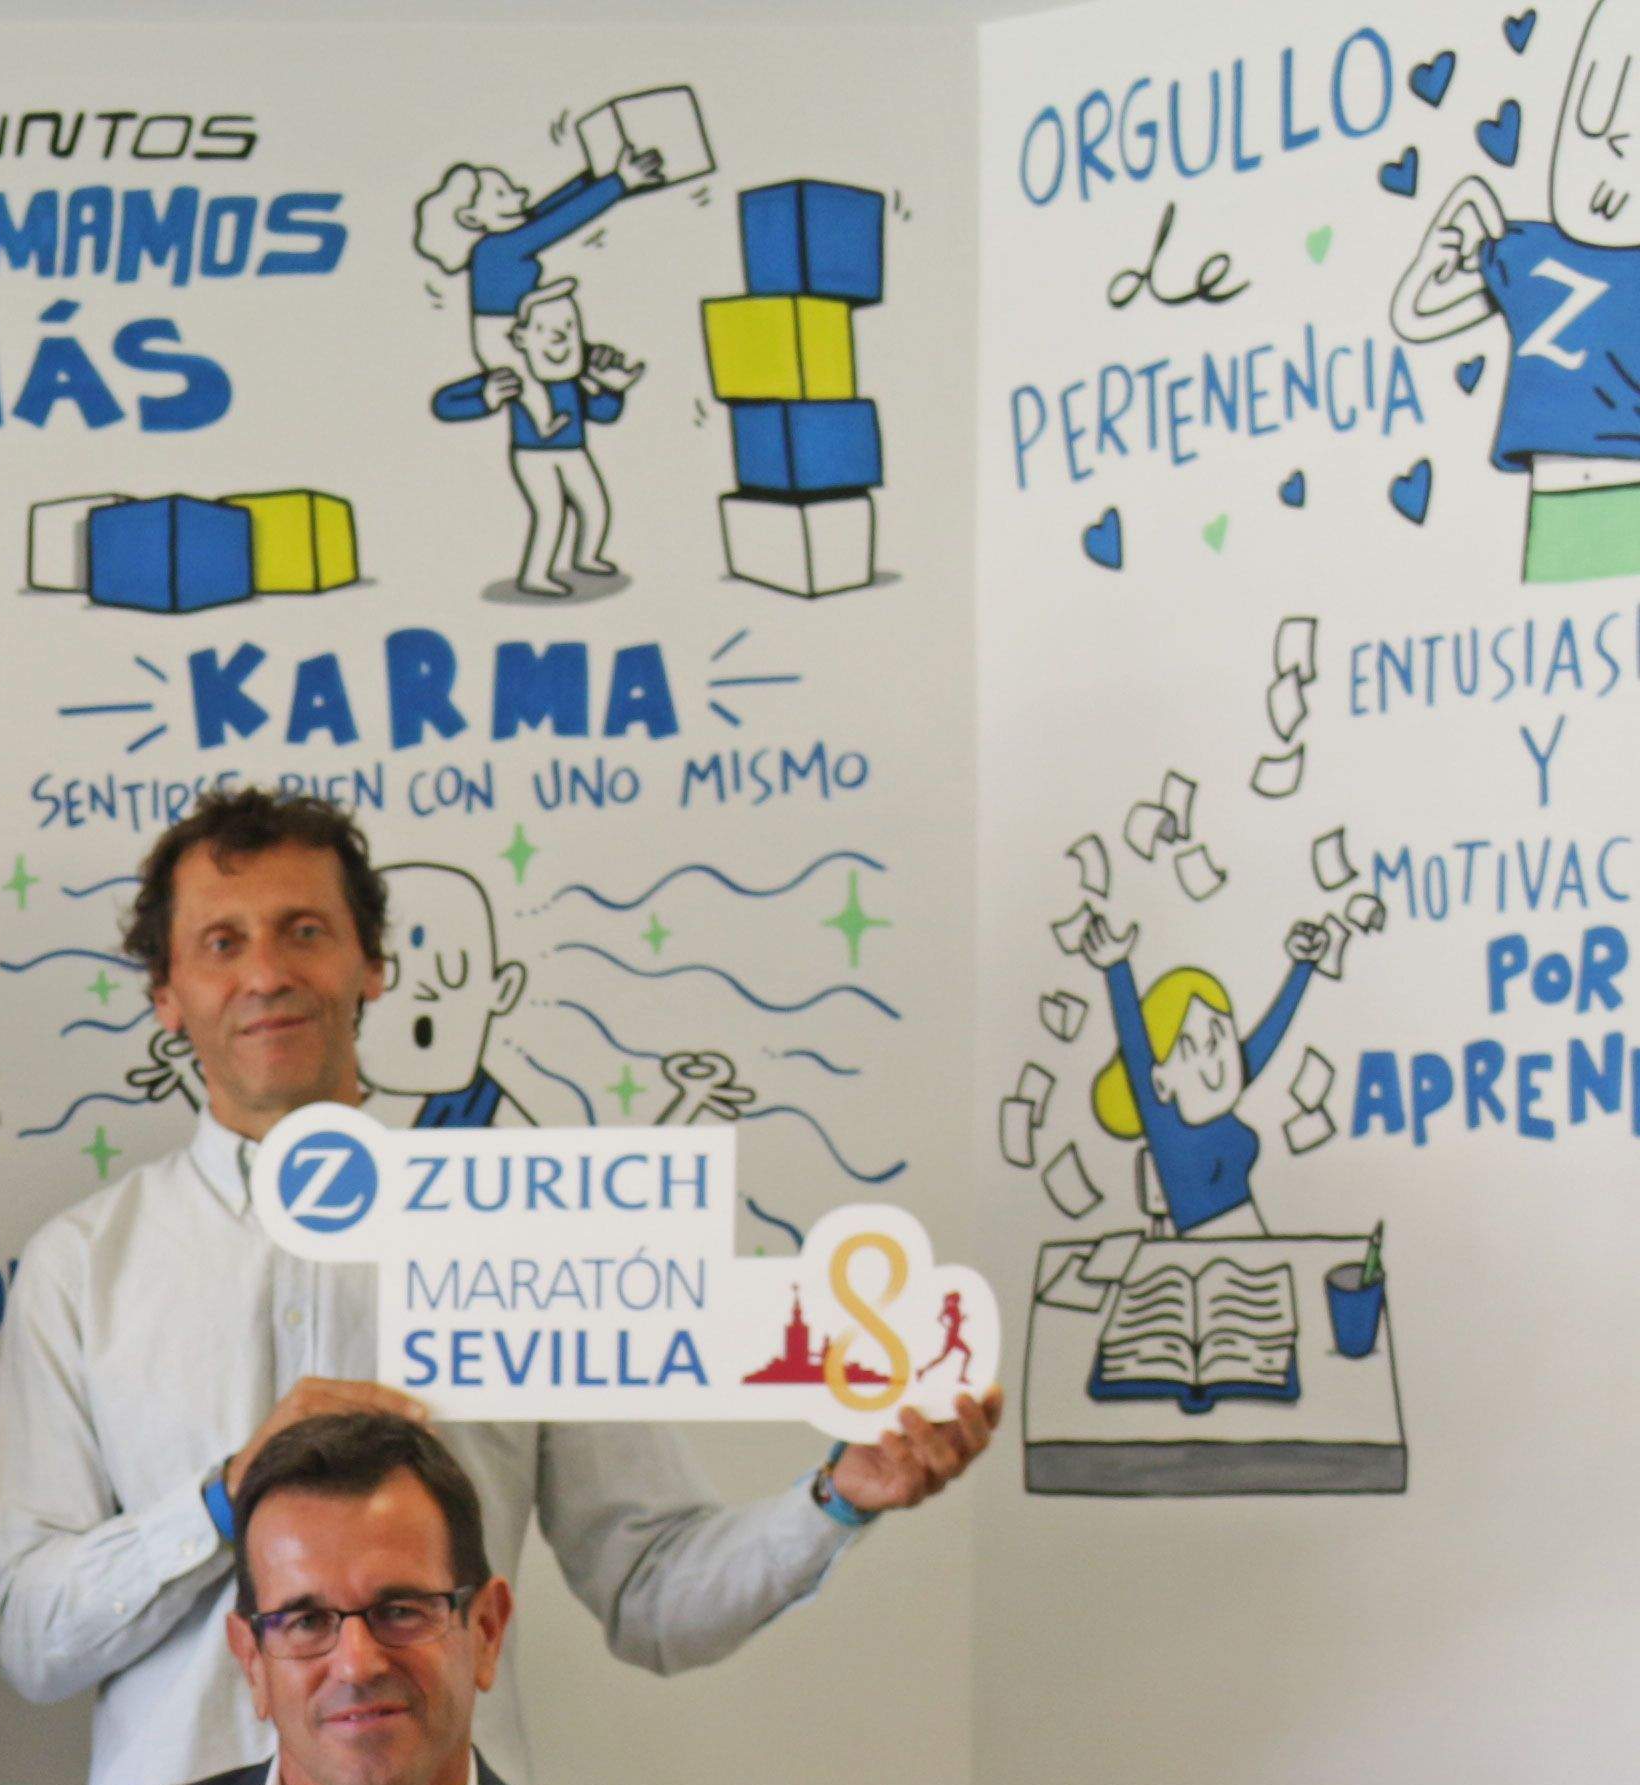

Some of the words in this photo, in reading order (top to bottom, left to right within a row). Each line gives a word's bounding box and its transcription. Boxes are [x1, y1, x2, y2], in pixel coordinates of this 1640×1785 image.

[1020, 26, 1392, 206] ORGULLO
[1011, 322, 1425, 491] PERTENENCIA
[187, 626, 680, 750] KARMA
[1349, 602, 1640, 716] ENTUSIAS
[409, 765, 494, 818] CON
[533, 758, 641, 810] UNO
[681, 740, 869, 808] MISMO
[1521, 714, 1566, 806] Y
[1488, 925, 1629, 1014] POR
[1350, 1031, 1640, 1146] APREN
[403, 1153, 709, 1212] ZURICH
[405, 1246, 707, 1311] MARATÓN
[402, 1329, 710, 1387] SEVILLA
